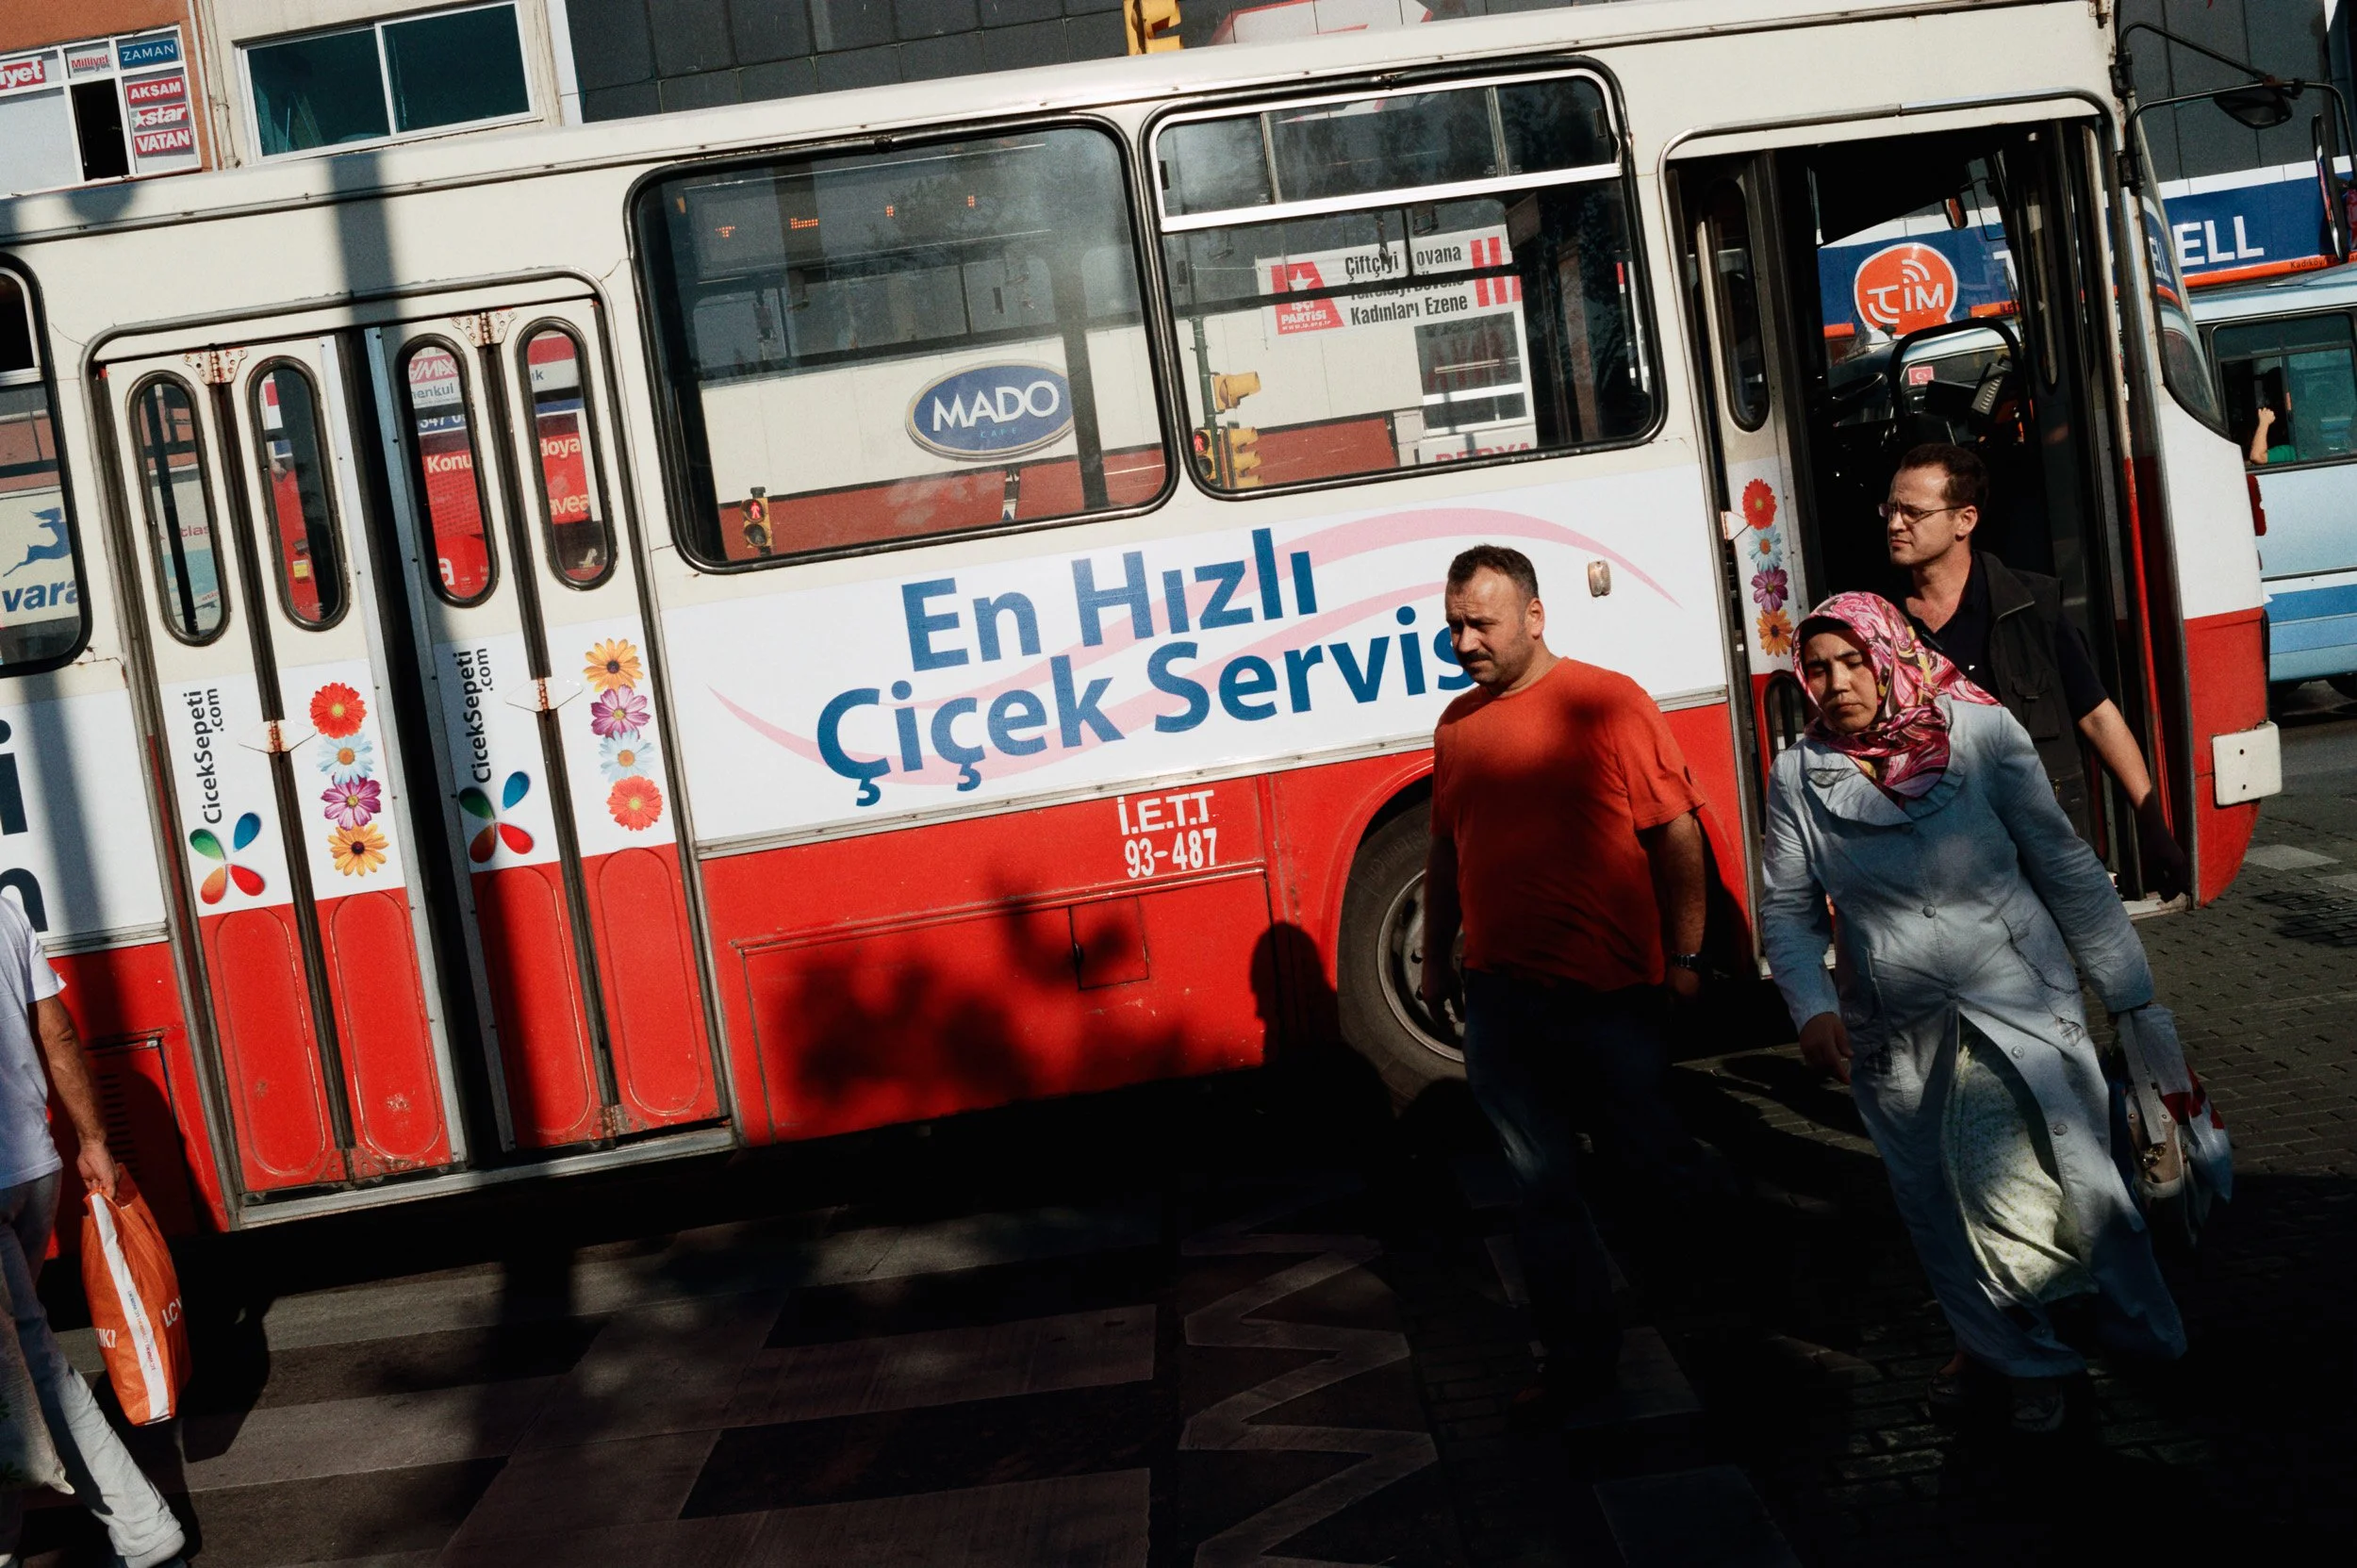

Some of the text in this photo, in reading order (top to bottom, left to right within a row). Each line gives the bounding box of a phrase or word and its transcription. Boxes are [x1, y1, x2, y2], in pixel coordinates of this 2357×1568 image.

[71, 53, 109, 70] Milliyet
[123, 43, 174, 61] ZAMAN
[145, 106, 186, 125] star
[137, 129, 191, 152] VATAN
[1416, 245, 1462, 267] ovana
[1350, 295, 1469, 326] Kadınları Ezene
[932, 380, 1061, 432] MADO
[900, 526, 1318, 672] En Hızlı
[476, 648, 494, 691] .com
[205, 687, 224, 733] .com
[453, 651, 492, 784] CicekSepeti
[816, 654, 1126, 807] Çiçek
[183, 690, 223, 825] CicekSepeti
[1124, 827, 1218, 880] 93-487
